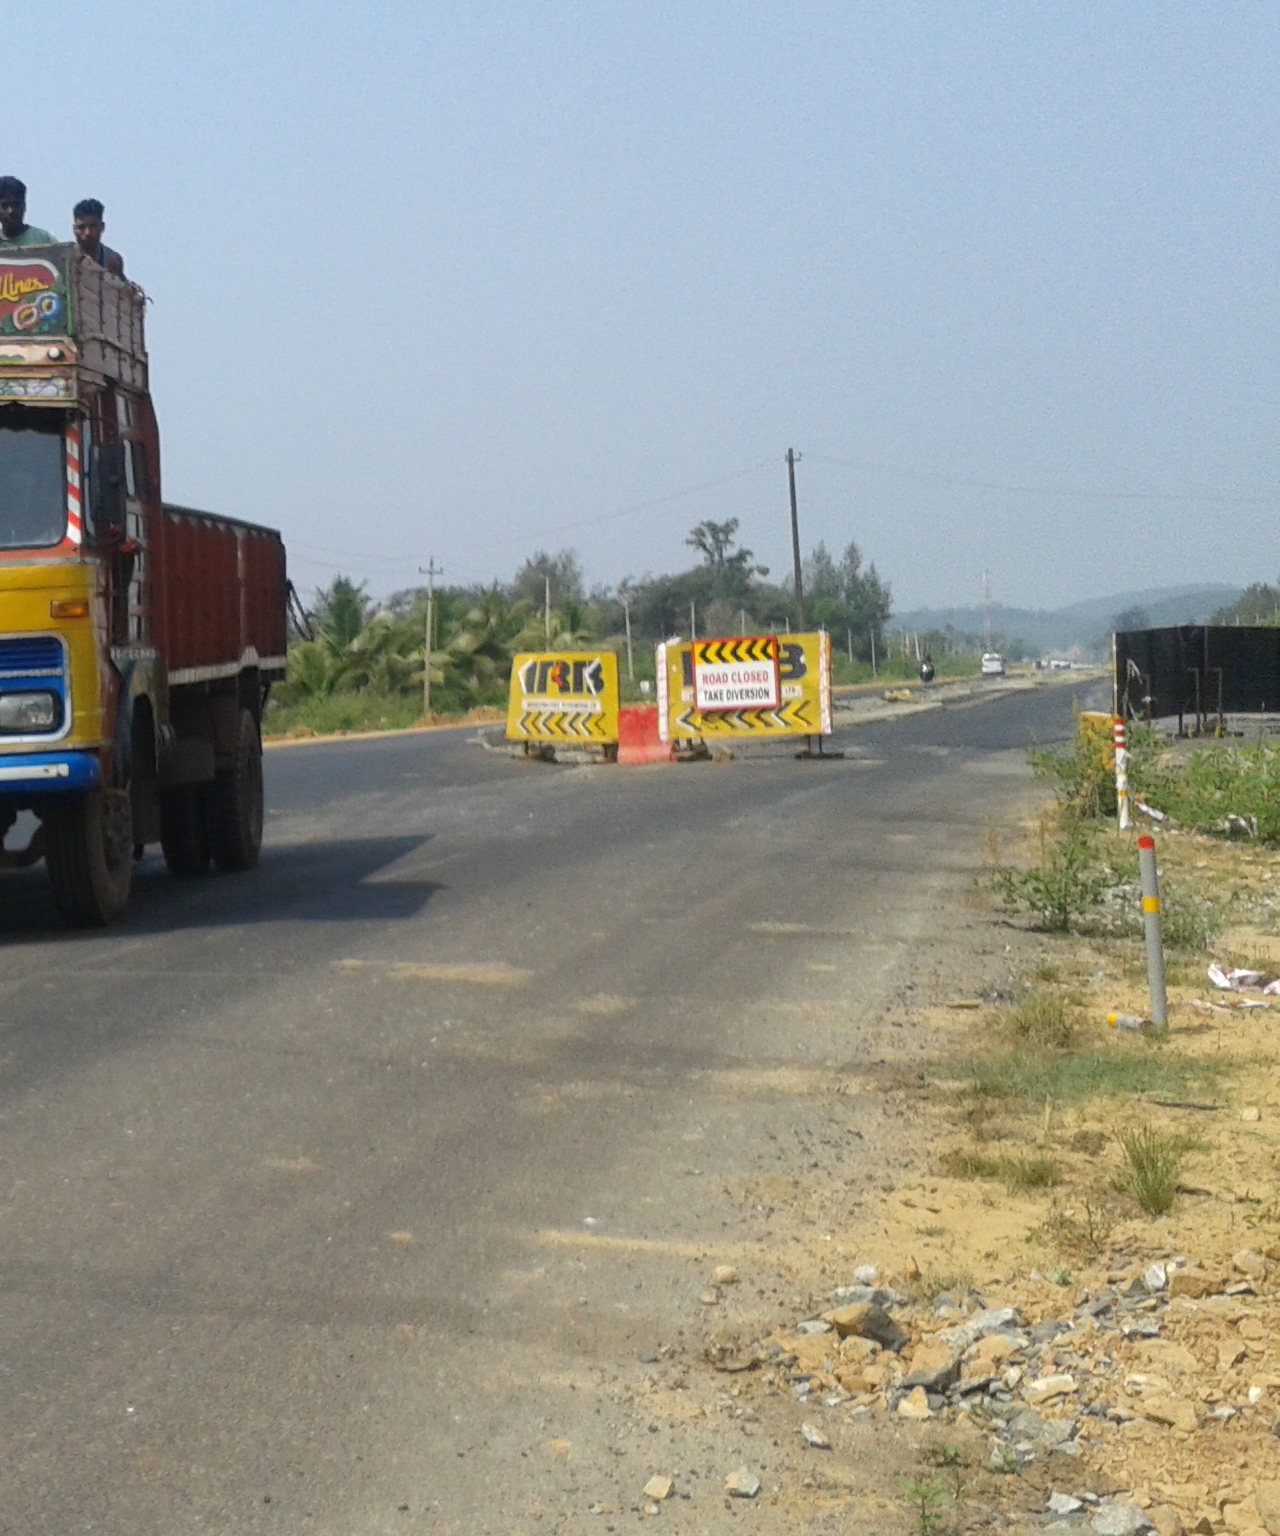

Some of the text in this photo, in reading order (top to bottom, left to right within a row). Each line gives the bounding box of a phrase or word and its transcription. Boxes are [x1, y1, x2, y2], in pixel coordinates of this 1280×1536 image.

[702, 670, 769, 685] ROAD CLOSED
[703, 687, 770, 702] TAKE DIVERSION
